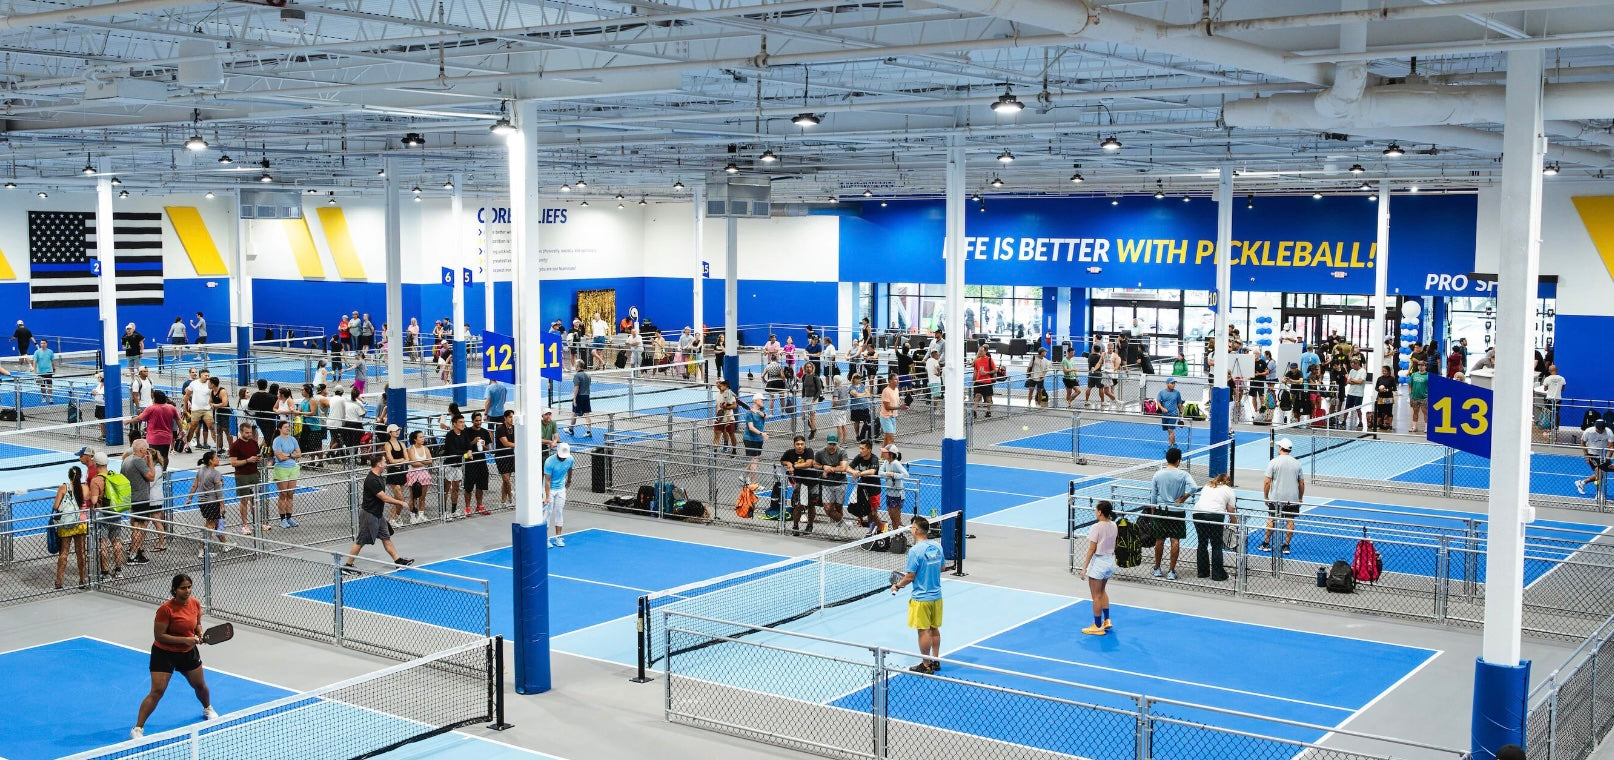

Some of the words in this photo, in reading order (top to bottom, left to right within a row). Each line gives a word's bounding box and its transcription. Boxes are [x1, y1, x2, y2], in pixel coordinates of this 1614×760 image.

[993, 237, 1015, 261] IS
[1018, 237, 1111, 263] BETTER
[1117, 238, 1188, 264] WITH
[94, 263, 100, 272] 2
[445, 272, 451, 283] 6
[464, 272, 470, 283] 5
[1425, 273, 1469, 291] PRO
[1208, 291, 1217, 307] 10
[485, 343, 513, 372] 12
[540, 342, 560, 369] 11
[1432, 396, 1489, 436] 13
